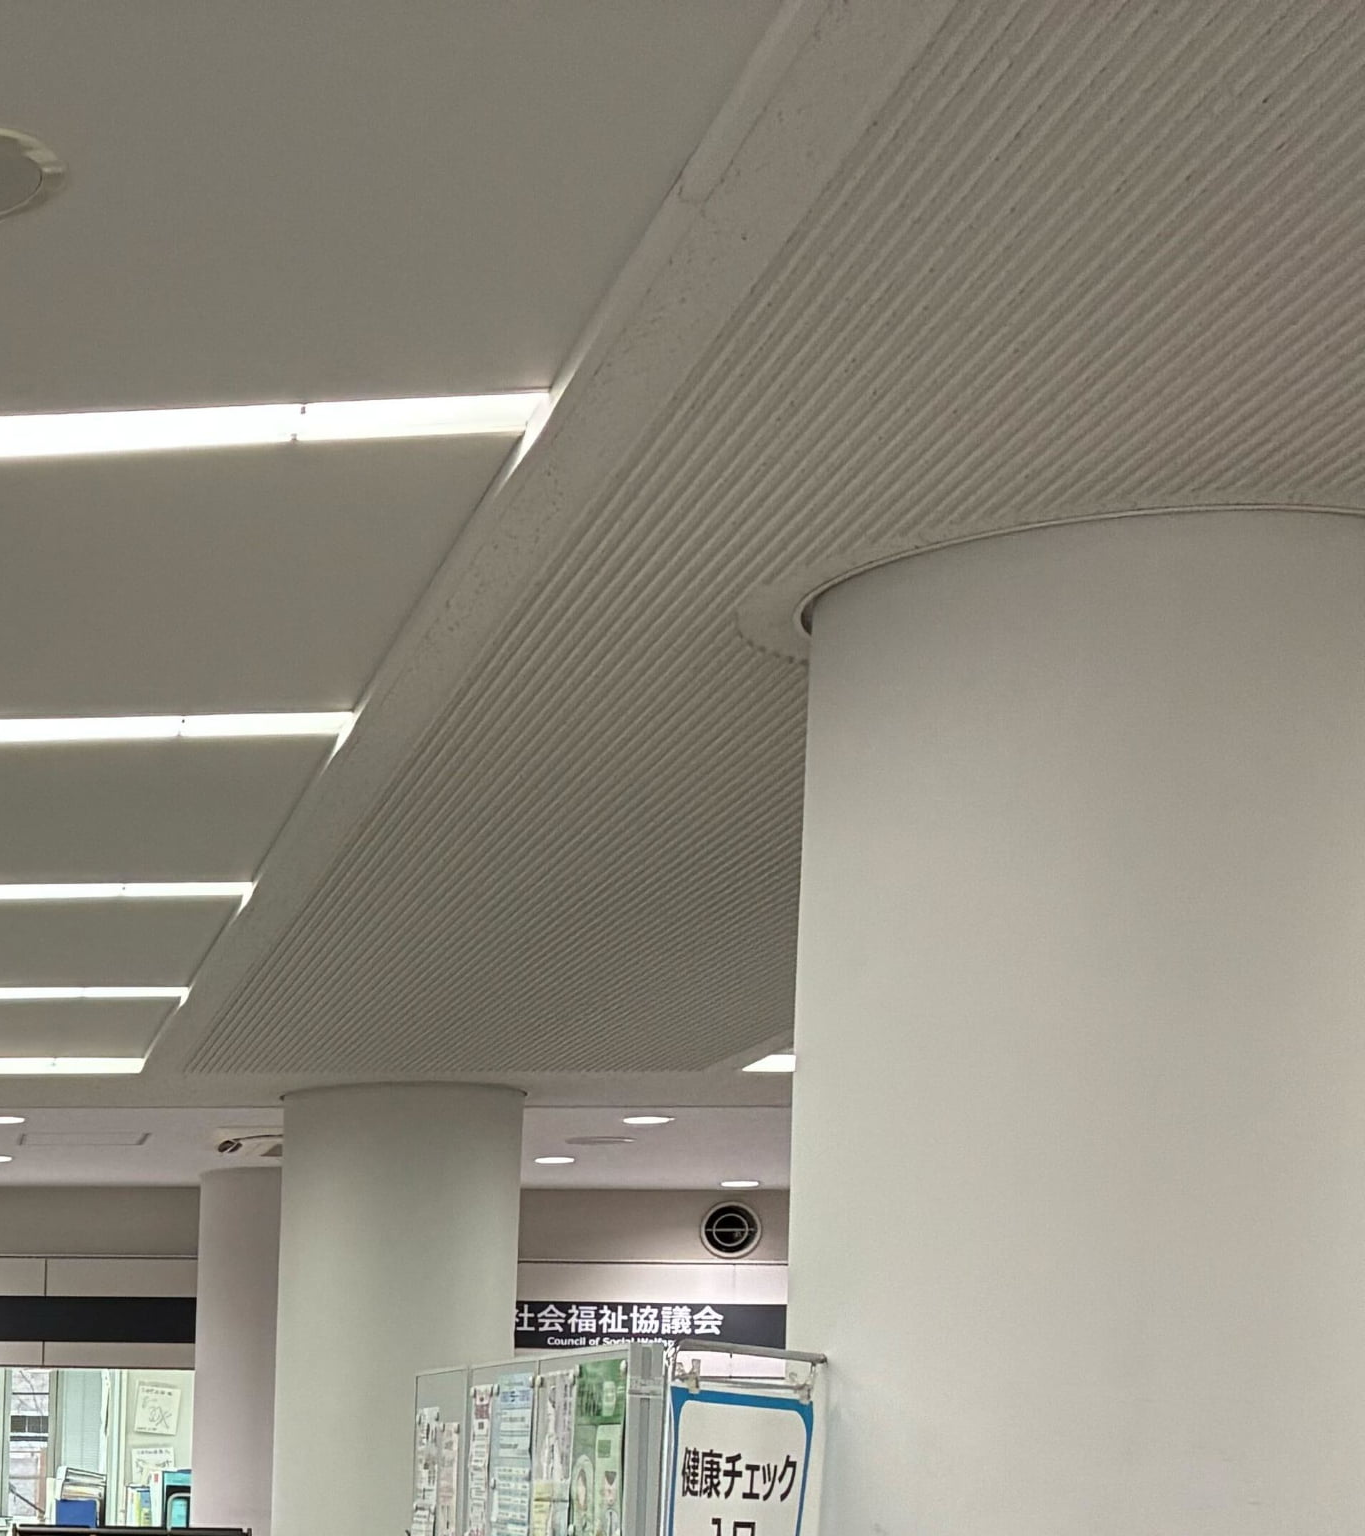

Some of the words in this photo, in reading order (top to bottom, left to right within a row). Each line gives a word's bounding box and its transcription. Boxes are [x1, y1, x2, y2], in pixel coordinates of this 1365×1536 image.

[515, 1304, 724, 1335] 社会福祉協議会
[547, 1337, 586, 1346] Council
[589, 1337, 600, 1346] of
[681, 1448, 797, 1502] 健康チェック
